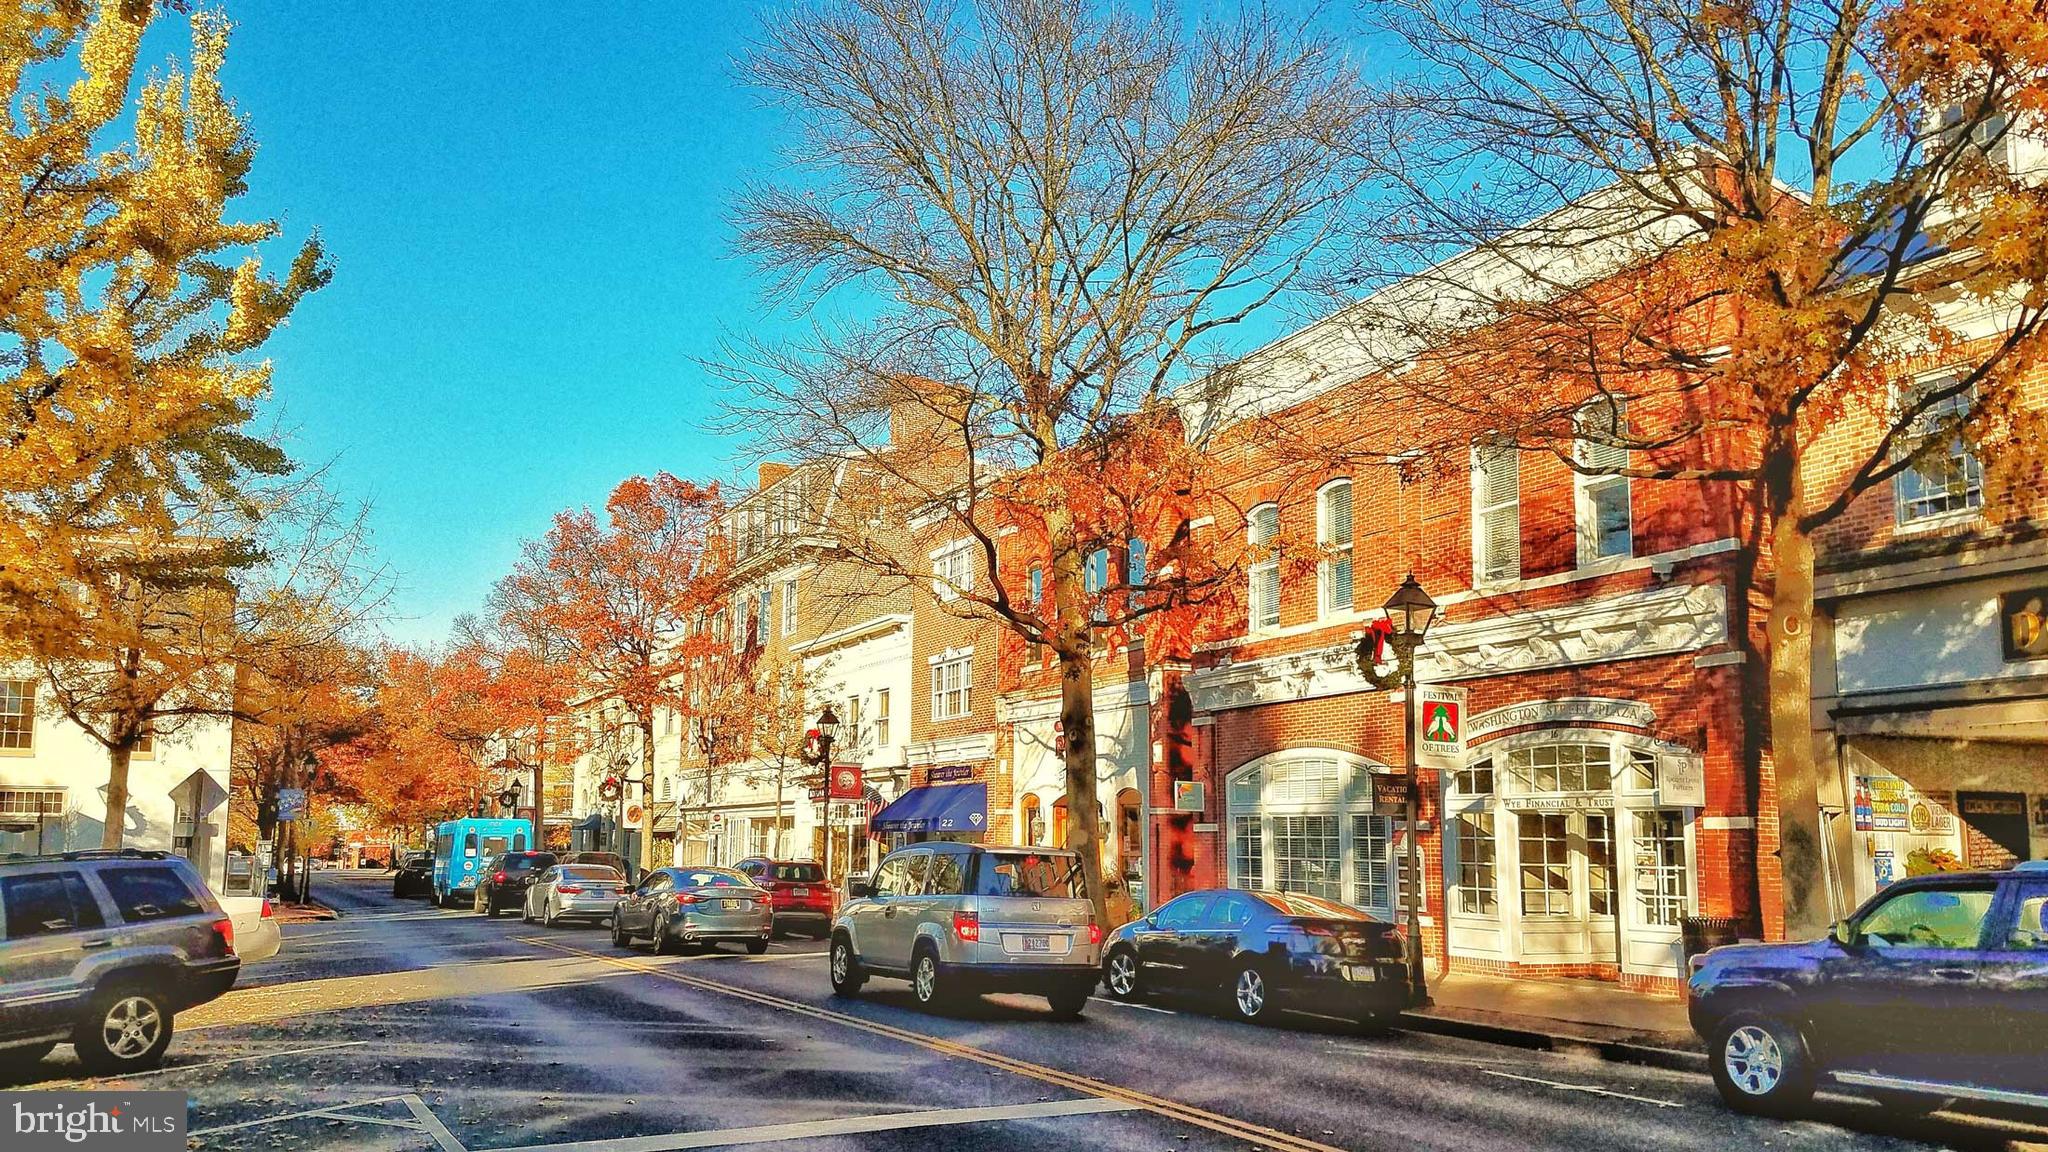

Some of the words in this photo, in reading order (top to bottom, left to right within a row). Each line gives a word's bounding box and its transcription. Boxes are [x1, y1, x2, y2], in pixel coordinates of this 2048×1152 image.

[1423, 691, 1458, 701] FESTIVAL
[1469, 706, 1539, 732] WASHINGTON
[1598, 703, 1638, 719] PLAZA
[1550, 730, 1559, 738] 16
[1422, 743, 1433, 752] OF
[1434, 744, 1460, 753] TREES
[1377, 784, 1408, 793] VACATIO
[1378, 795, 1407, 803] RENTAL
[1503, 799, 1521, 808] WYE
[1526, 799, 1570, 808] FINANCIAL
[1574, 799, 1583, 808] &
[1588, 797, 1614, 807] TRUST
[1890, 803, 1905, 813] COLD
[941, 819, 954, 827] 22
[1875, 819, 1888, 827] BUD
[1888, 819, 1906, 827] LIGHT
[1931, 815, 1951, 828] LAGER
